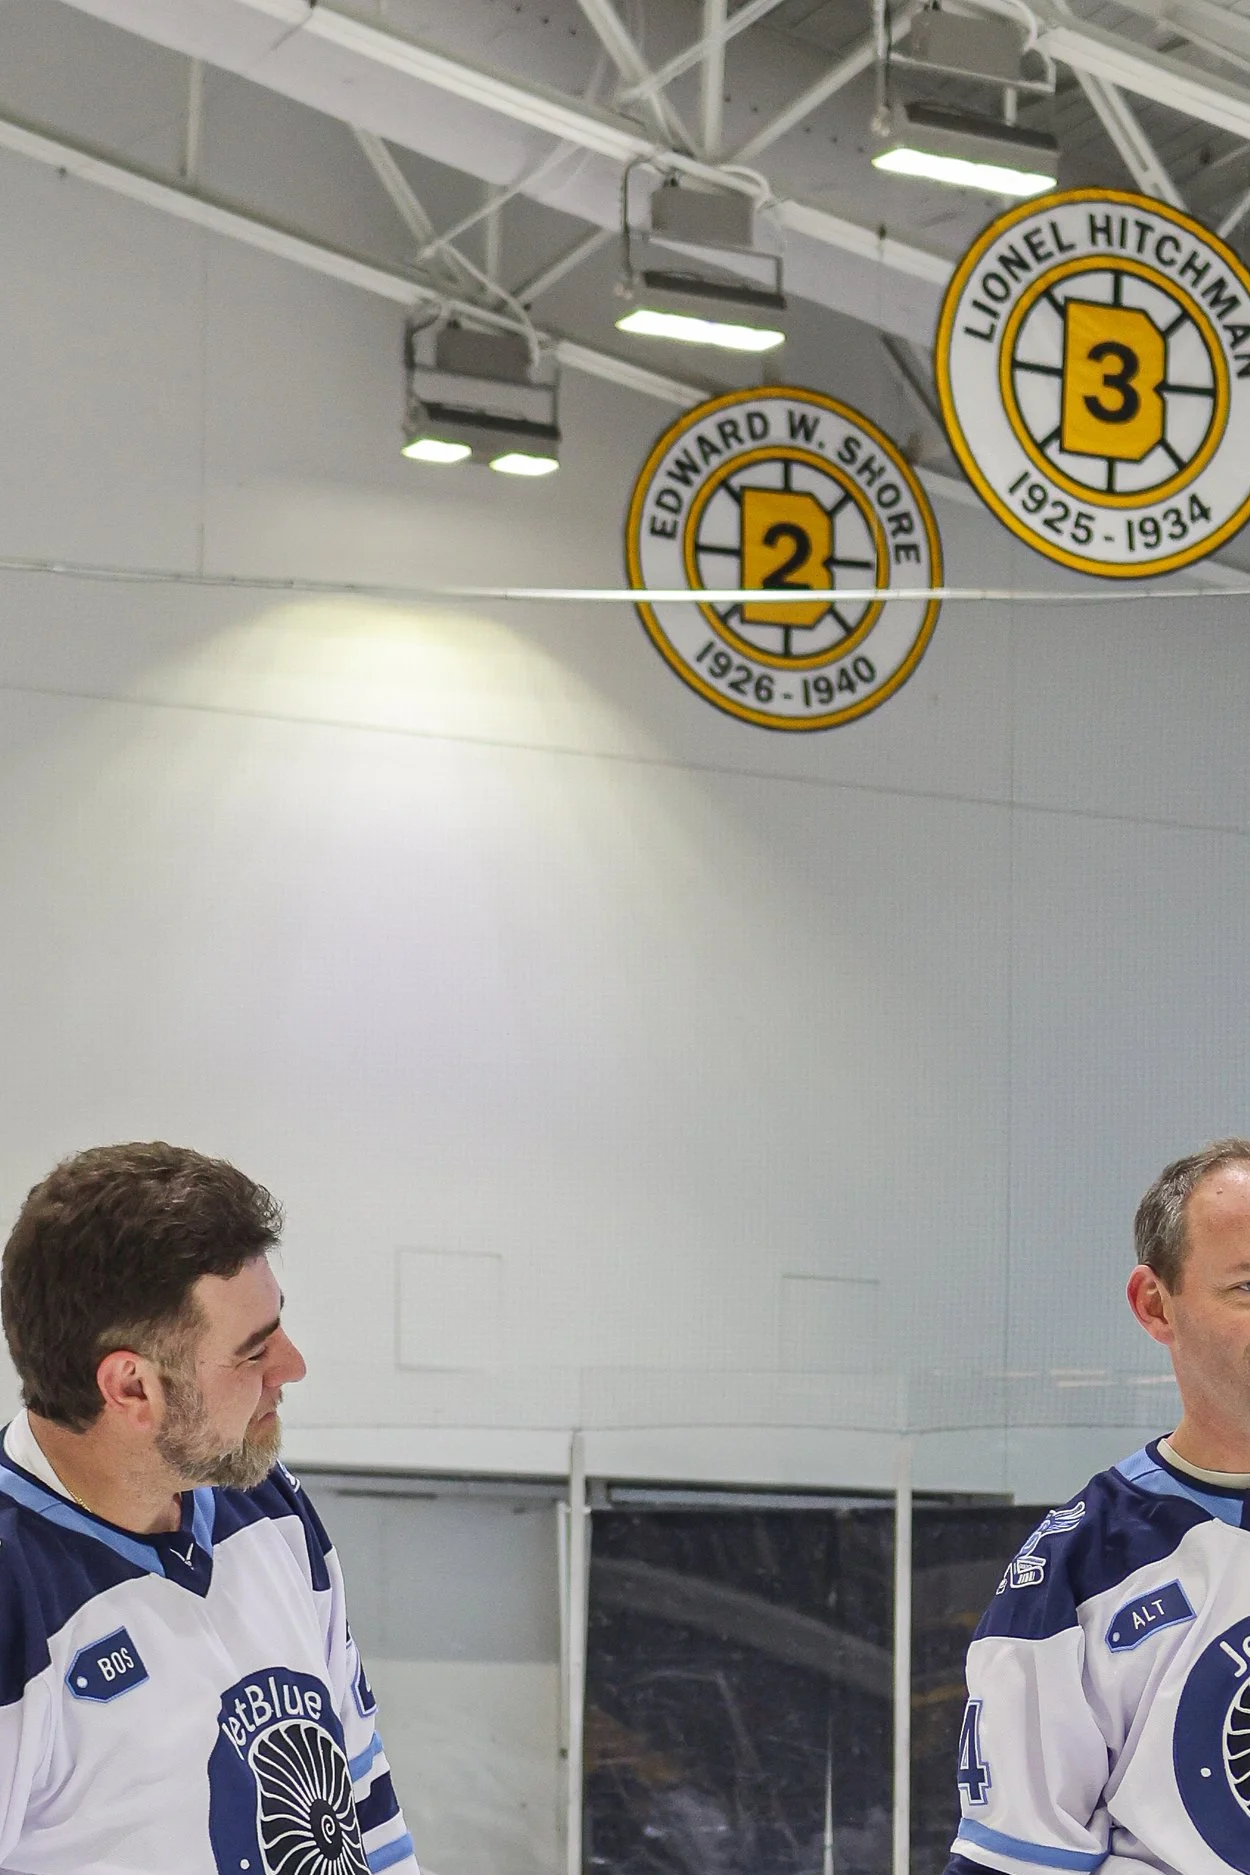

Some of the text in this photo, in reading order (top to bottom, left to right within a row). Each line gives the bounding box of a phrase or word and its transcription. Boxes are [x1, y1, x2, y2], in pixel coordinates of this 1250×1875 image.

[964, 220, 1077, 344] LIONEL
[1083, 341, 1140, 424] 3
[649, 409, 922, 566] EDWARD W. SHORE
[763, 522, 814, 590] 2
[1131, 1599, 1165, 1630] ALT
[97, 1647, 136, 1682] BOS
[958, 1698, 992, 1805] 4
